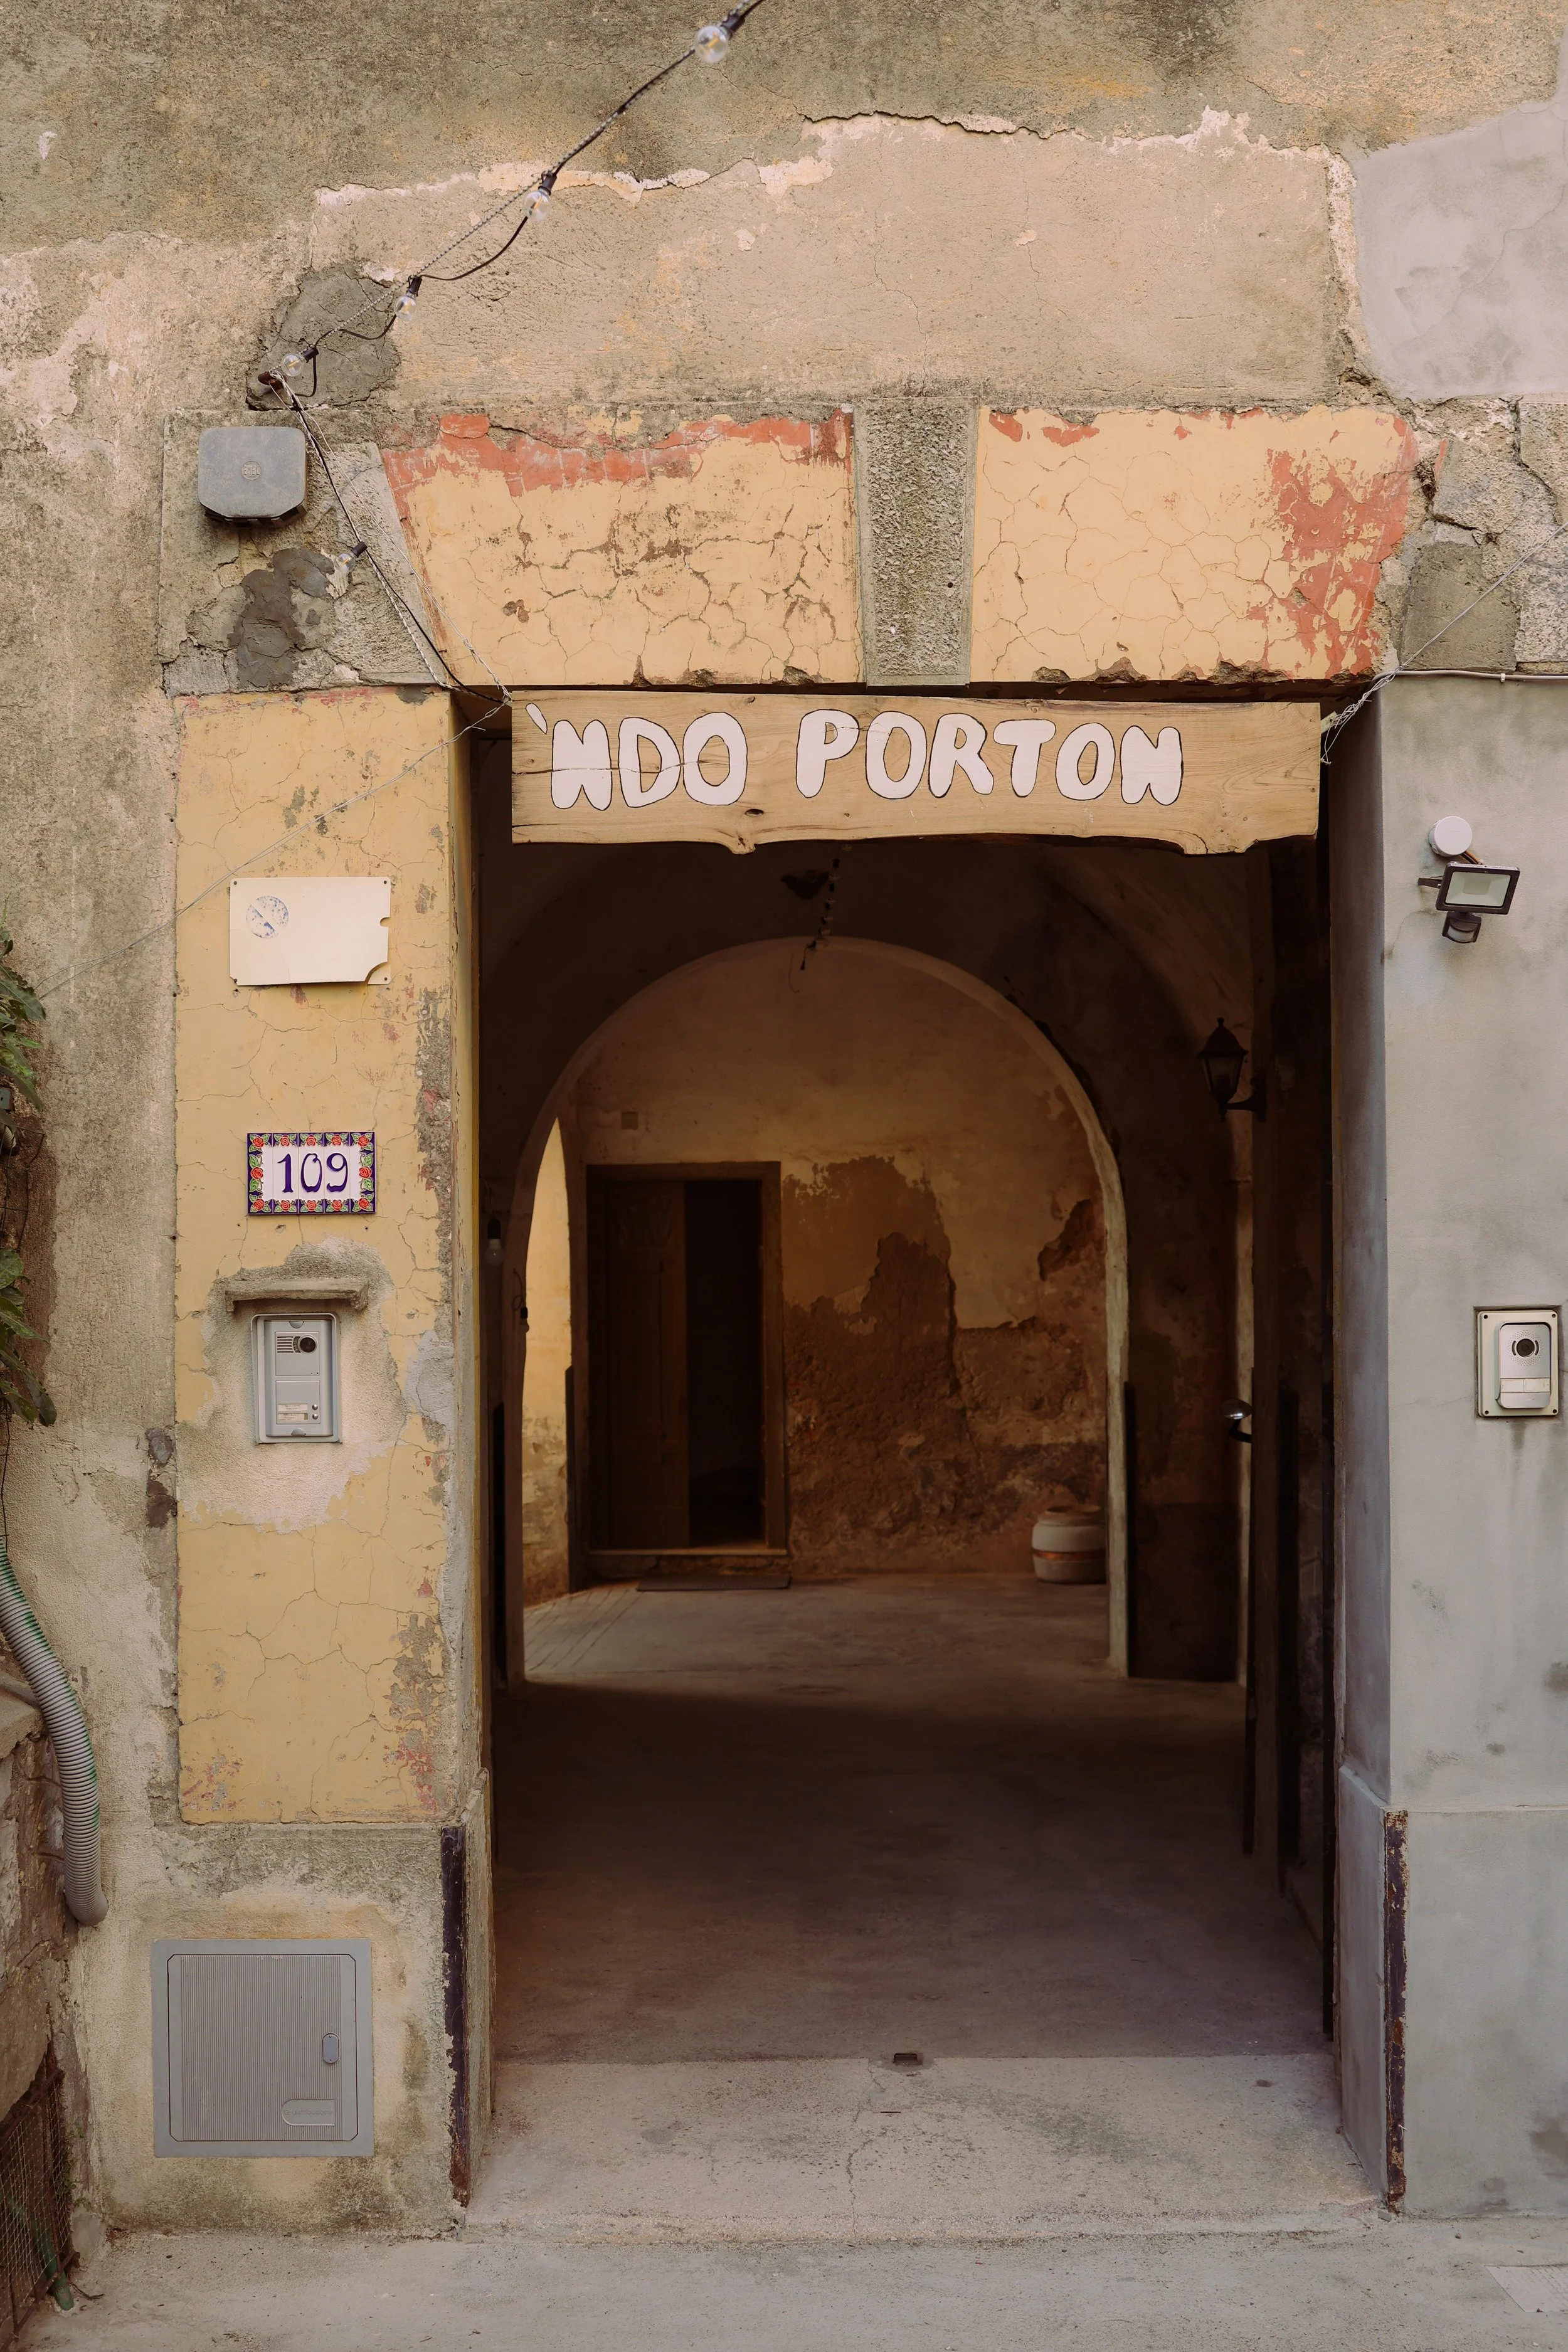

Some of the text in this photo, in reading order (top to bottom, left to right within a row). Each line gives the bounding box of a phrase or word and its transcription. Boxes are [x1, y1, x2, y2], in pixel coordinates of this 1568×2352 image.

[243, 466, 259, 475] ENEL
[795, 709, 1184, 806] PORTON
[277, 1152, 348, 1193] 109
